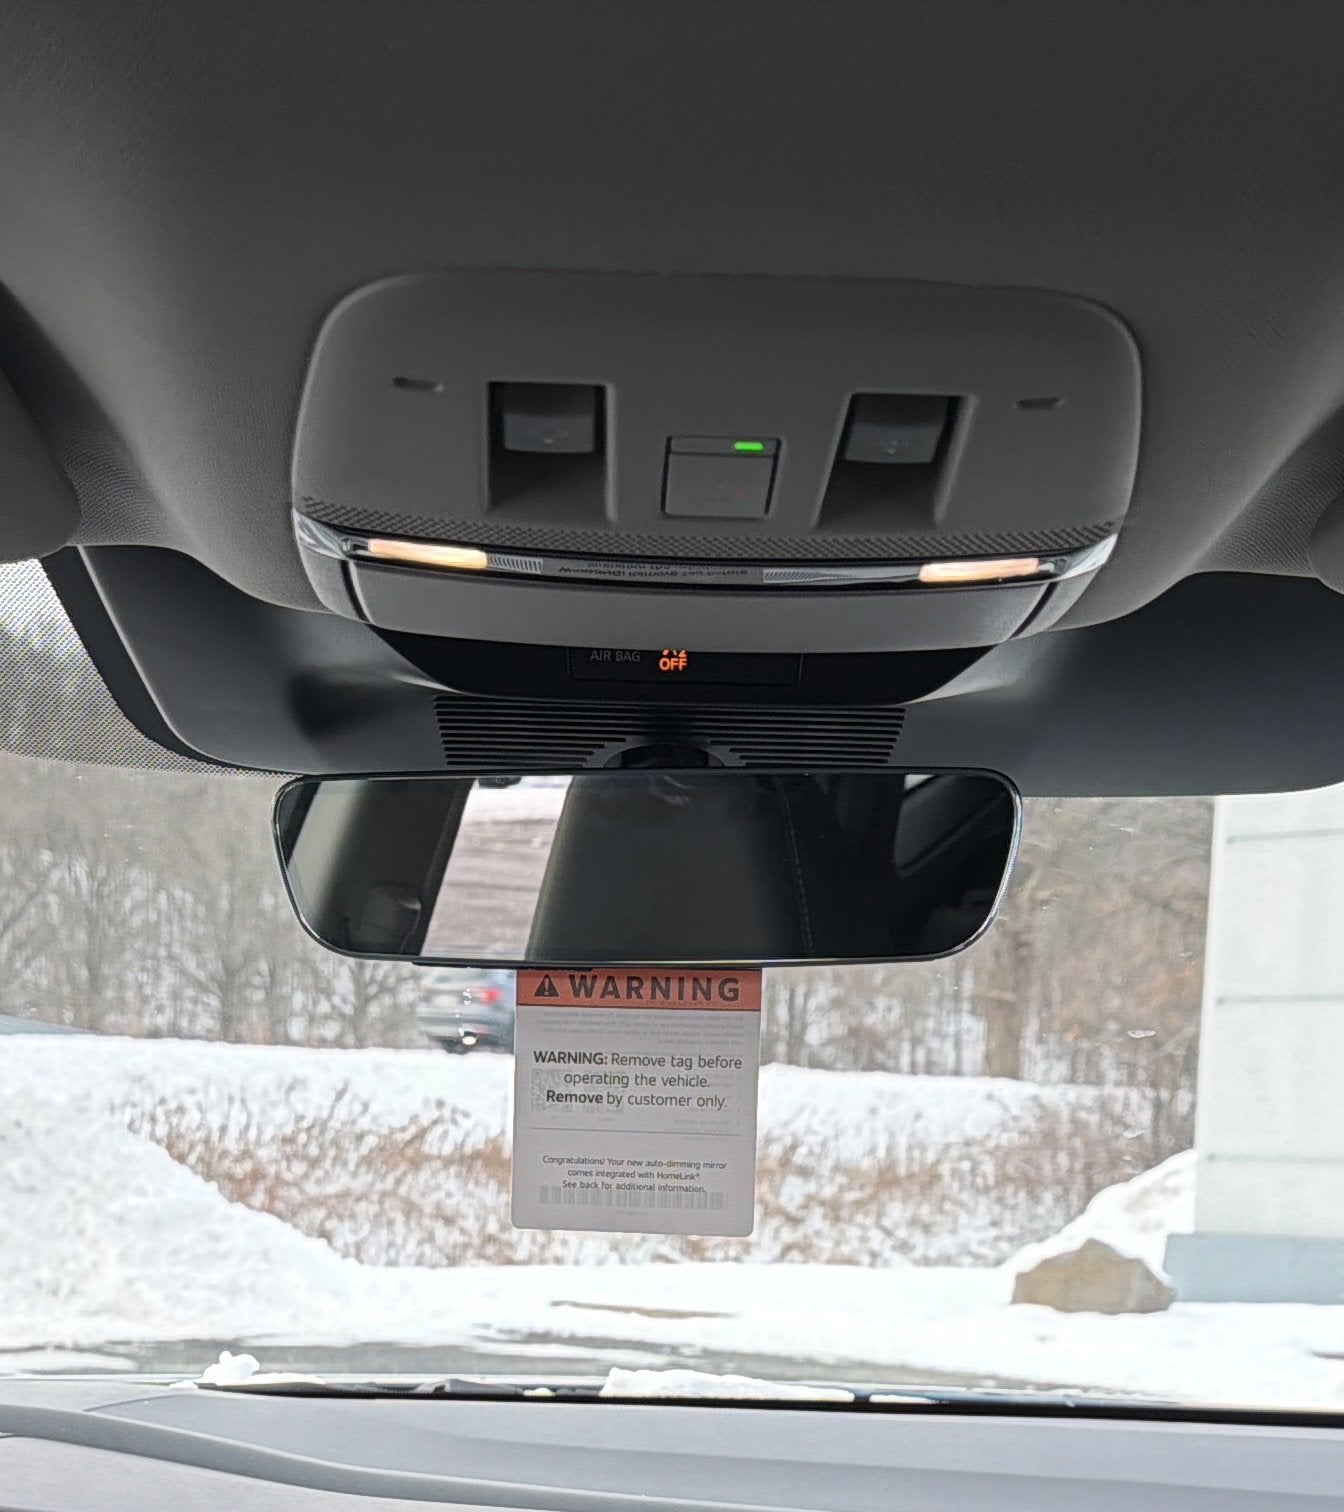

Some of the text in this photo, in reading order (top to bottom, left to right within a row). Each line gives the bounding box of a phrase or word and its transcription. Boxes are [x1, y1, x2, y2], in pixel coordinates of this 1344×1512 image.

[590, 649, 641, 662] AIR BAG
[659, 658, 688, 671] OFF
[568, 974, 740, 1002] WARNING
[533, 1050, 743, 1070] WARNING: Remove tag before
[563, 1072, 710, 1088] operating the vehicle.
[546, 1090, 728, 1110] Remove by customer only.
[607, 1157, 625, 1167] Your
[626, 1159, 644, 1167] new
[645, 1159, 701, 1170] auto-dimming
[702, 1161, 727, 1169] mirror
[567, 1169, 593, 1177] comes
[595, 1169, 636, 1180] integrated
[637, 1170, 655, 1179] with
[562, 1180, 578, 1188] See
[579, 1181, 599, 1189] back
[601, 1182, 612, 1190] for
[615, 1182, 656, 1191] additional
